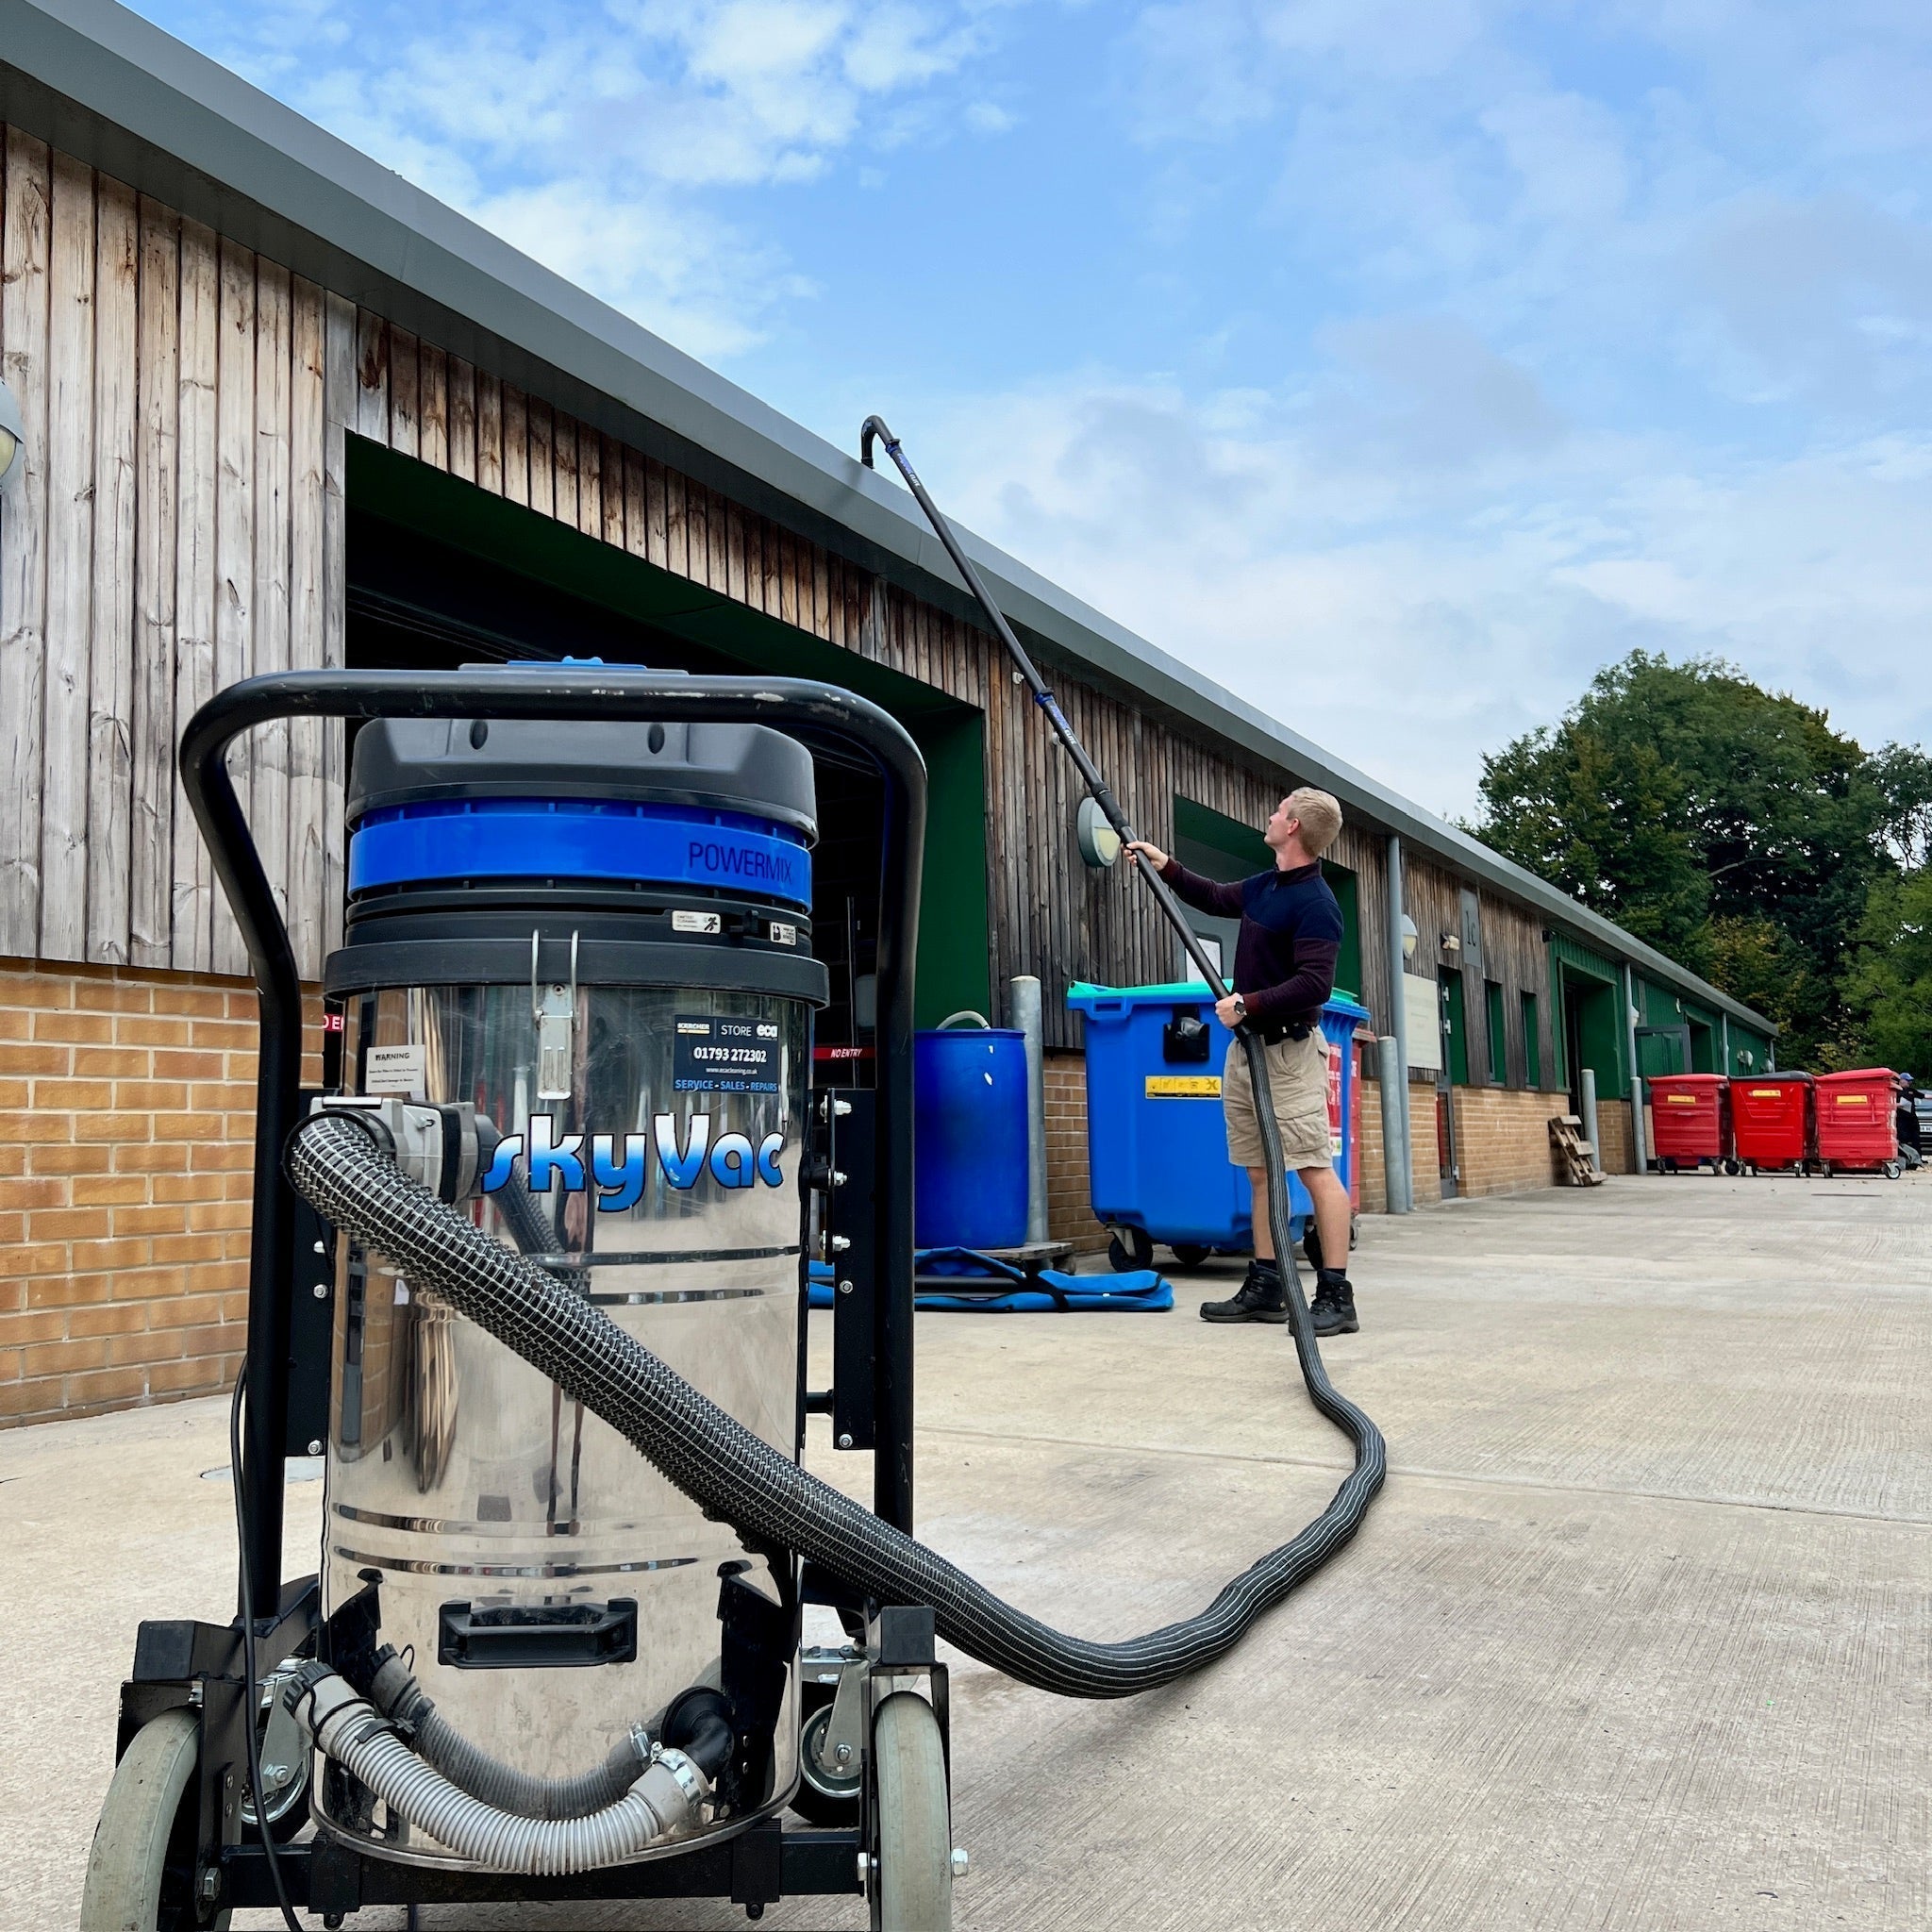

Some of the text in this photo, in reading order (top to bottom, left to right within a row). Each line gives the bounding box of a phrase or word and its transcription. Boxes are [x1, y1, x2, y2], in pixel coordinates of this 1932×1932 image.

[689, 841, 792, 885] POWERMIX
[721, 1024, 752, 1037] STORE
[375, 1052, 410, 1061] WARNING
[693, 1046, 767, 1063] 01793 272302
[831, 1048, 862, 1058] NO ENTRY
[675, 1079, 714, 1090] SERVICE
[720, 1080, 745, 1091] SALES
[750, 1082, 777, 1092] REPAIRS
